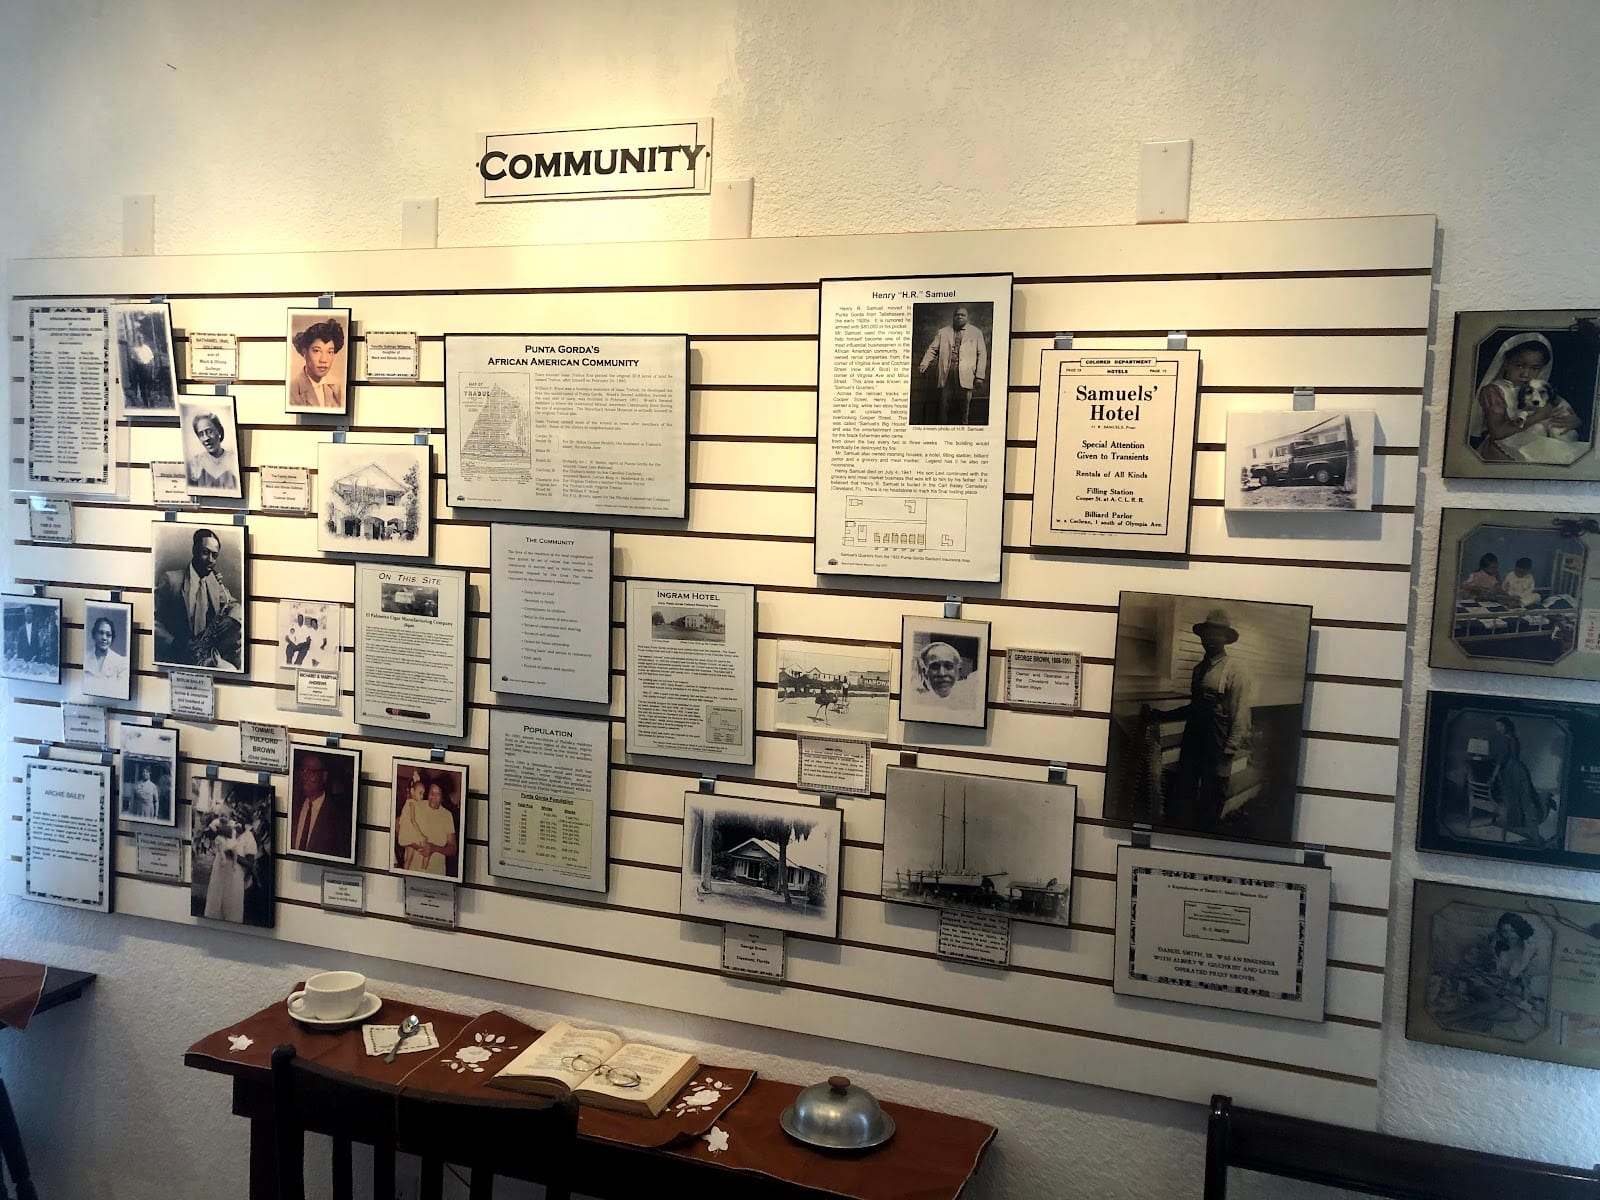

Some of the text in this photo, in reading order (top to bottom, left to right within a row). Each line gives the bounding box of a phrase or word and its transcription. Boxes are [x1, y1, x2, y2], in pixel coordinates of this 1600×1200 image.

[480, 144, 705, 180] COMMUNITY
[872, 291, 895, 300] Henry
[525, 345, 600, 354] PUNTA GORDA'S
[488, 358, 639, 367] AFRICAN AMERICAN COMMUNITY
[1076, 385, 1157, 400] Samuels’
[1090, 405, 1139, 420] Hotel
[1082, 440, 1107, 449] Special
[1077, 451, 1097, 460] Given
[1111, 452, 1149, 461] Transients
[1087, 488, 1107, 496] Filling
[398, 574, 416, 582] THIS
[422, 577, 442, 585] SITE
[657, 591, 720, 601] INGRAM HOTEL
[252, 726, 275, 734] TOMMIE
[523, 725, 573, 738] POPULATION
[253, 746, 275, 754] BROWN
